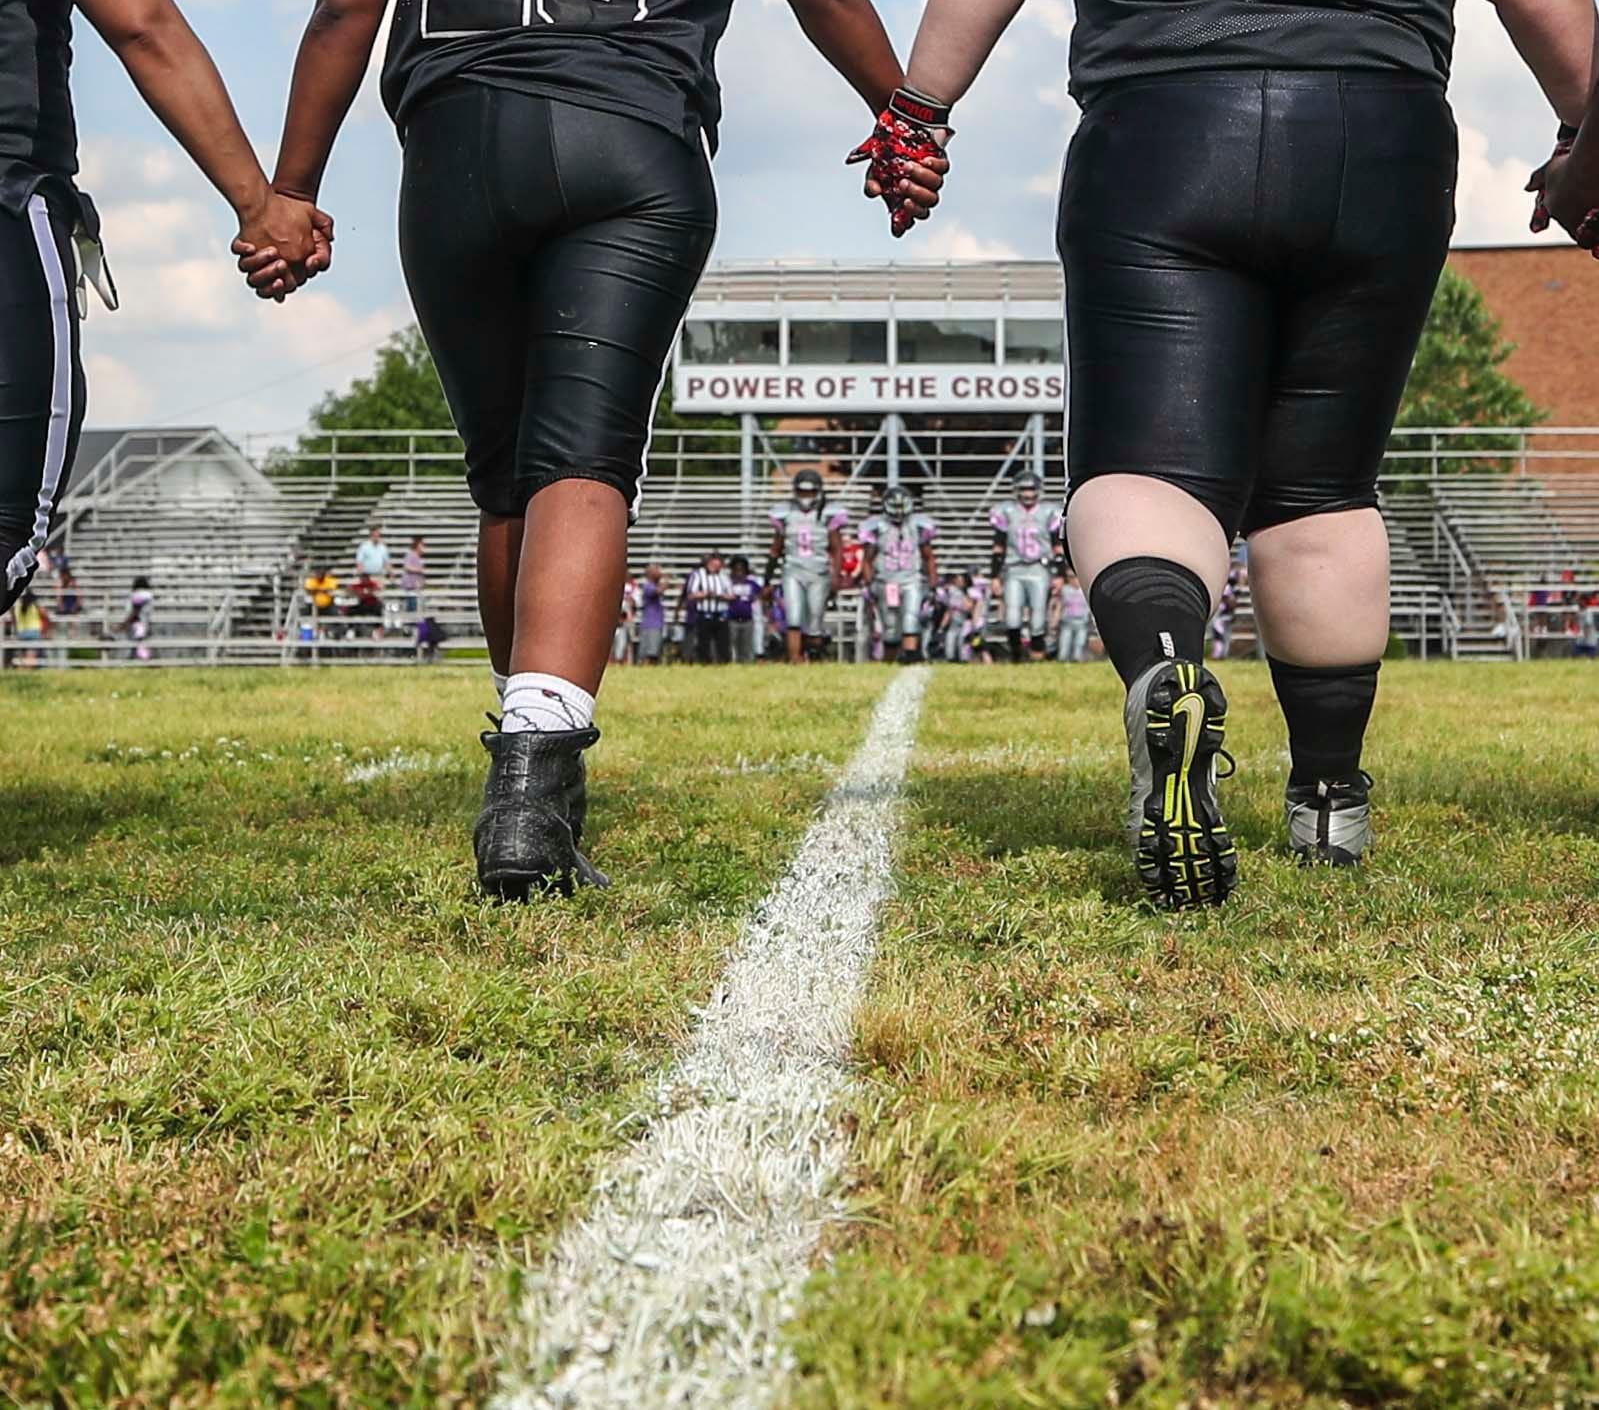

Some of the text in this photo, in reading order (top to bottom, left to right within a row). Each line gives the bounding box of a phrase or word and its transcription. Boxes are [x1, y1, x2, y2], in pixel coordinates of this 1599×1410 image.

[687, 376, 1063, 399] POWER OF THE CROSS
[1016, 526, 1042, 559] 15
